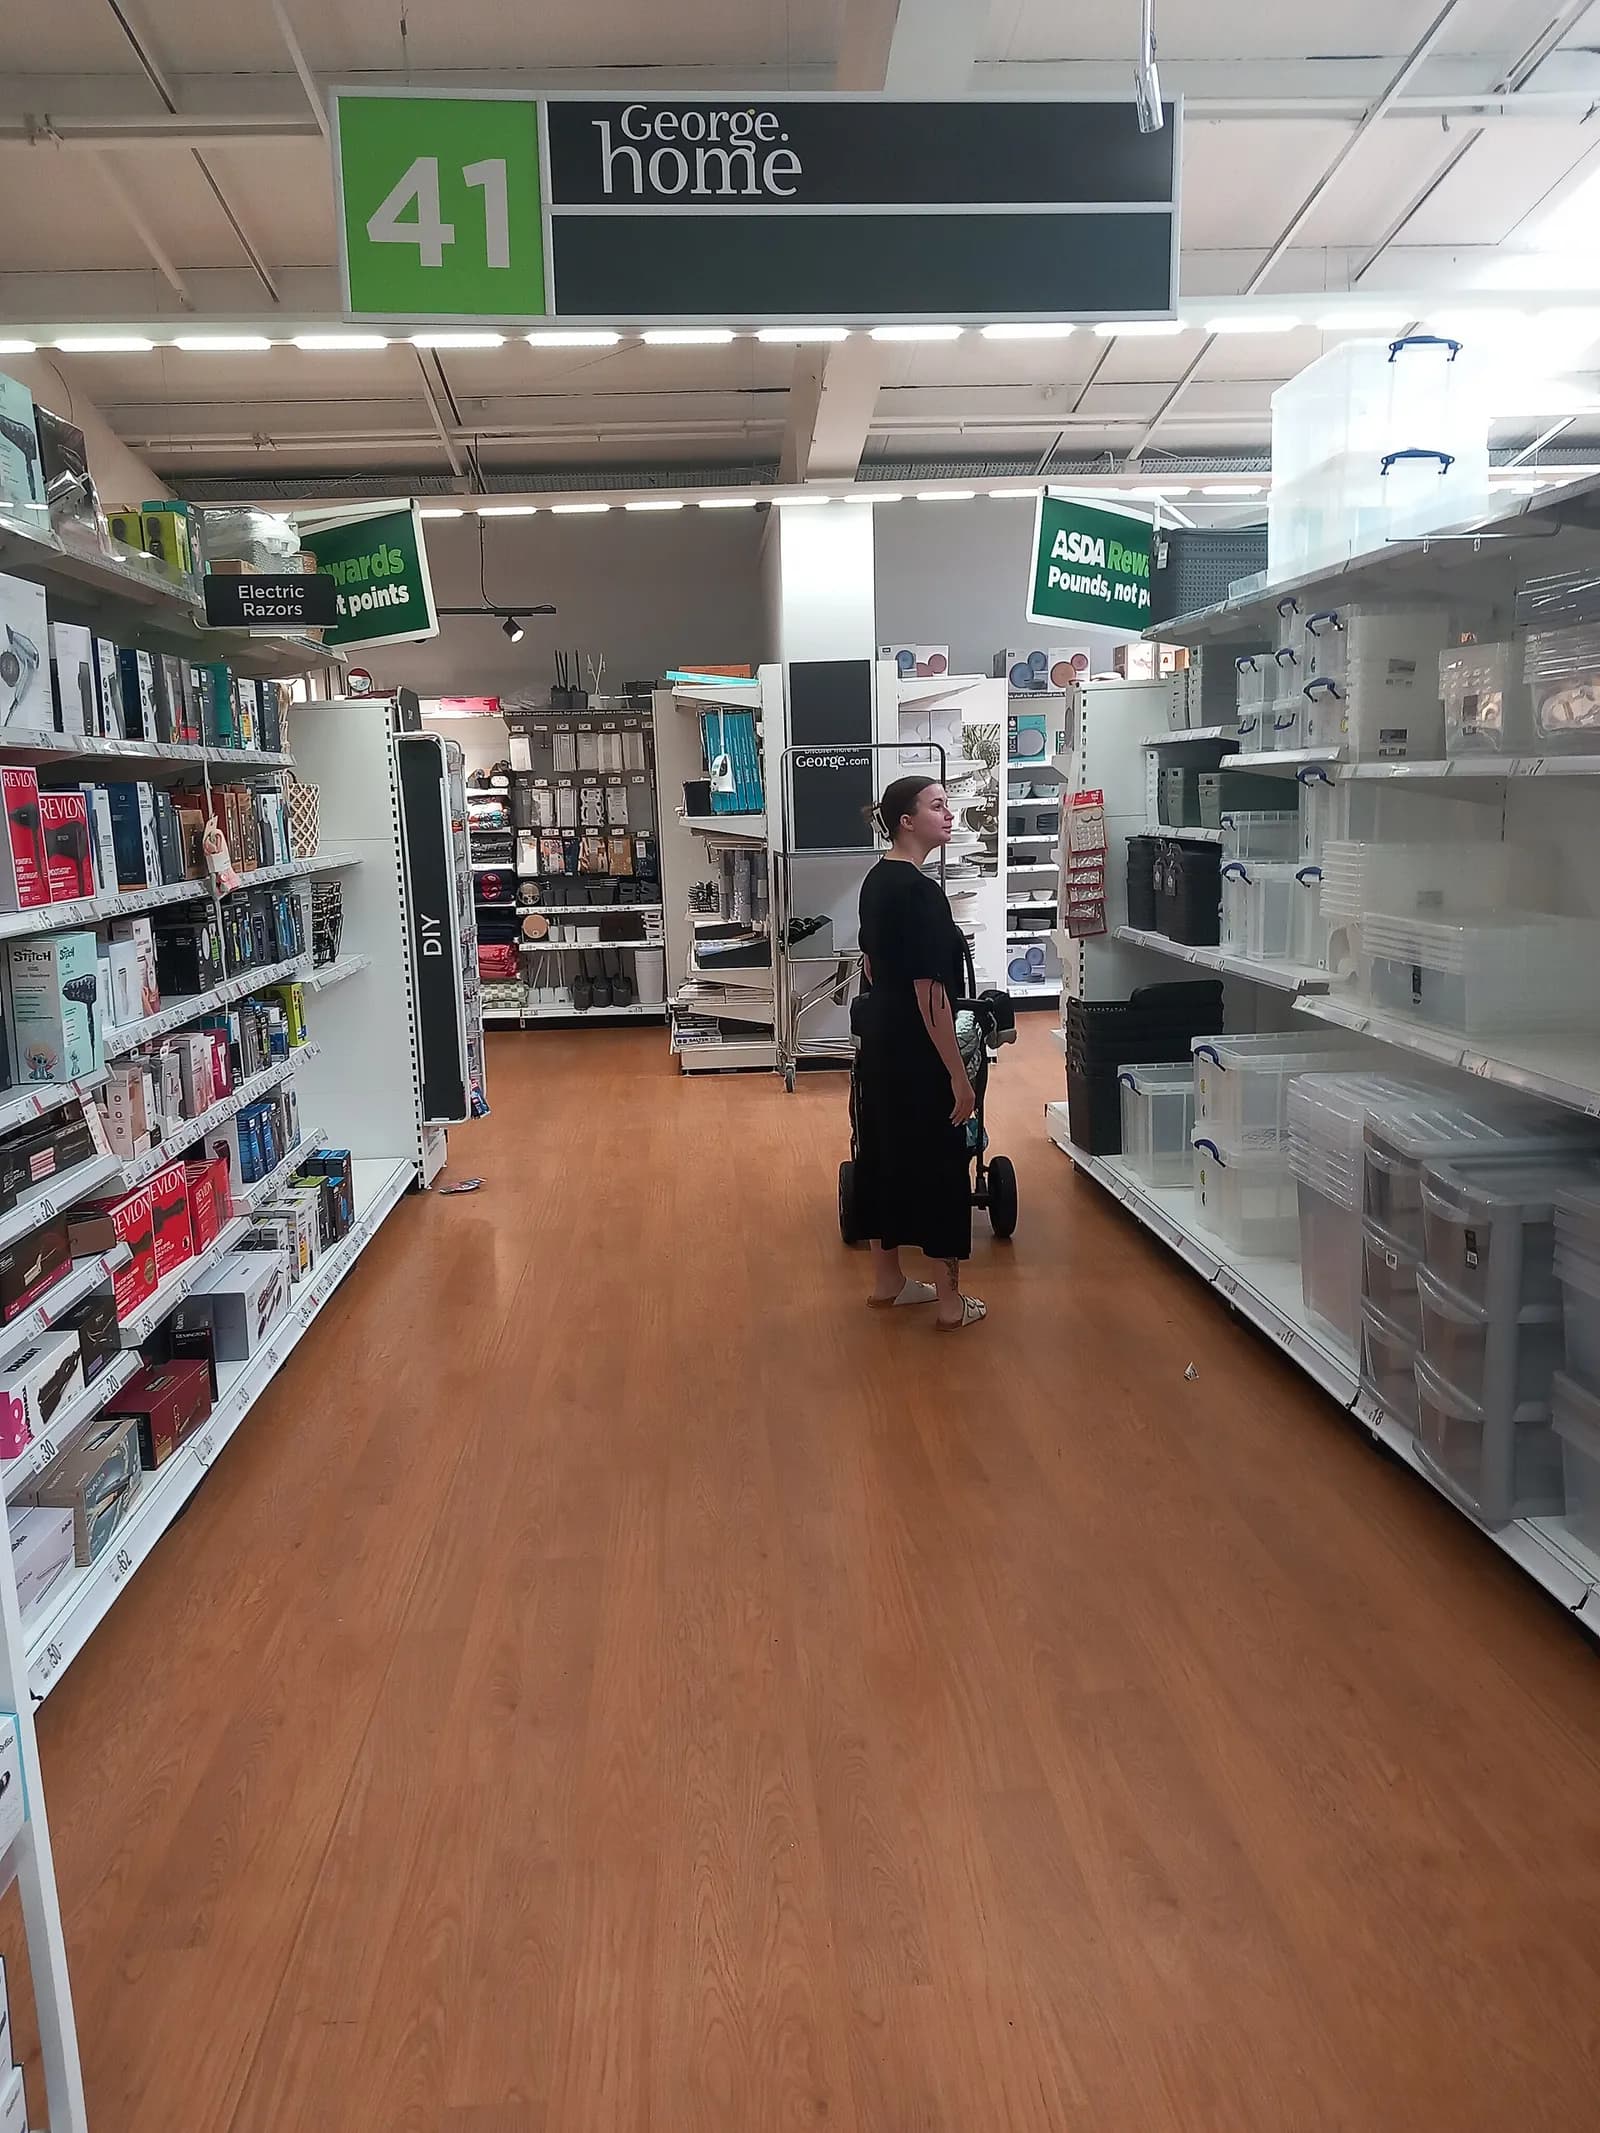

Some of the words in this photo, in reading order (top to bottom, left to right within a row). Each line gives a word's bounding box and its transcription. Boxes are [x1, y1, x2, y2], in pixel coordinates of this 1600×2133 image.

[620, 104, 790, 154] George.
[591, 119, 803, 196] home
[366, 156, 511, 269] 41
[1050, 529, 1106, 568] ASDA
[238, 584, 305, 600] Electric
[349, 583, 410, 618] points
[1047, 565, 1111, 602] Pounds,
[1113, 582, 1137, 604] not
[243, 602, 303, 617] Razors
[3, 771, 37, 788] REVLON
[796, 755, 870, 770] George.com
[40, 797, 86, 820] REVLON
[420, 913, 443, 957] DIY
[149, 1165, 185, 1202] EVLON
